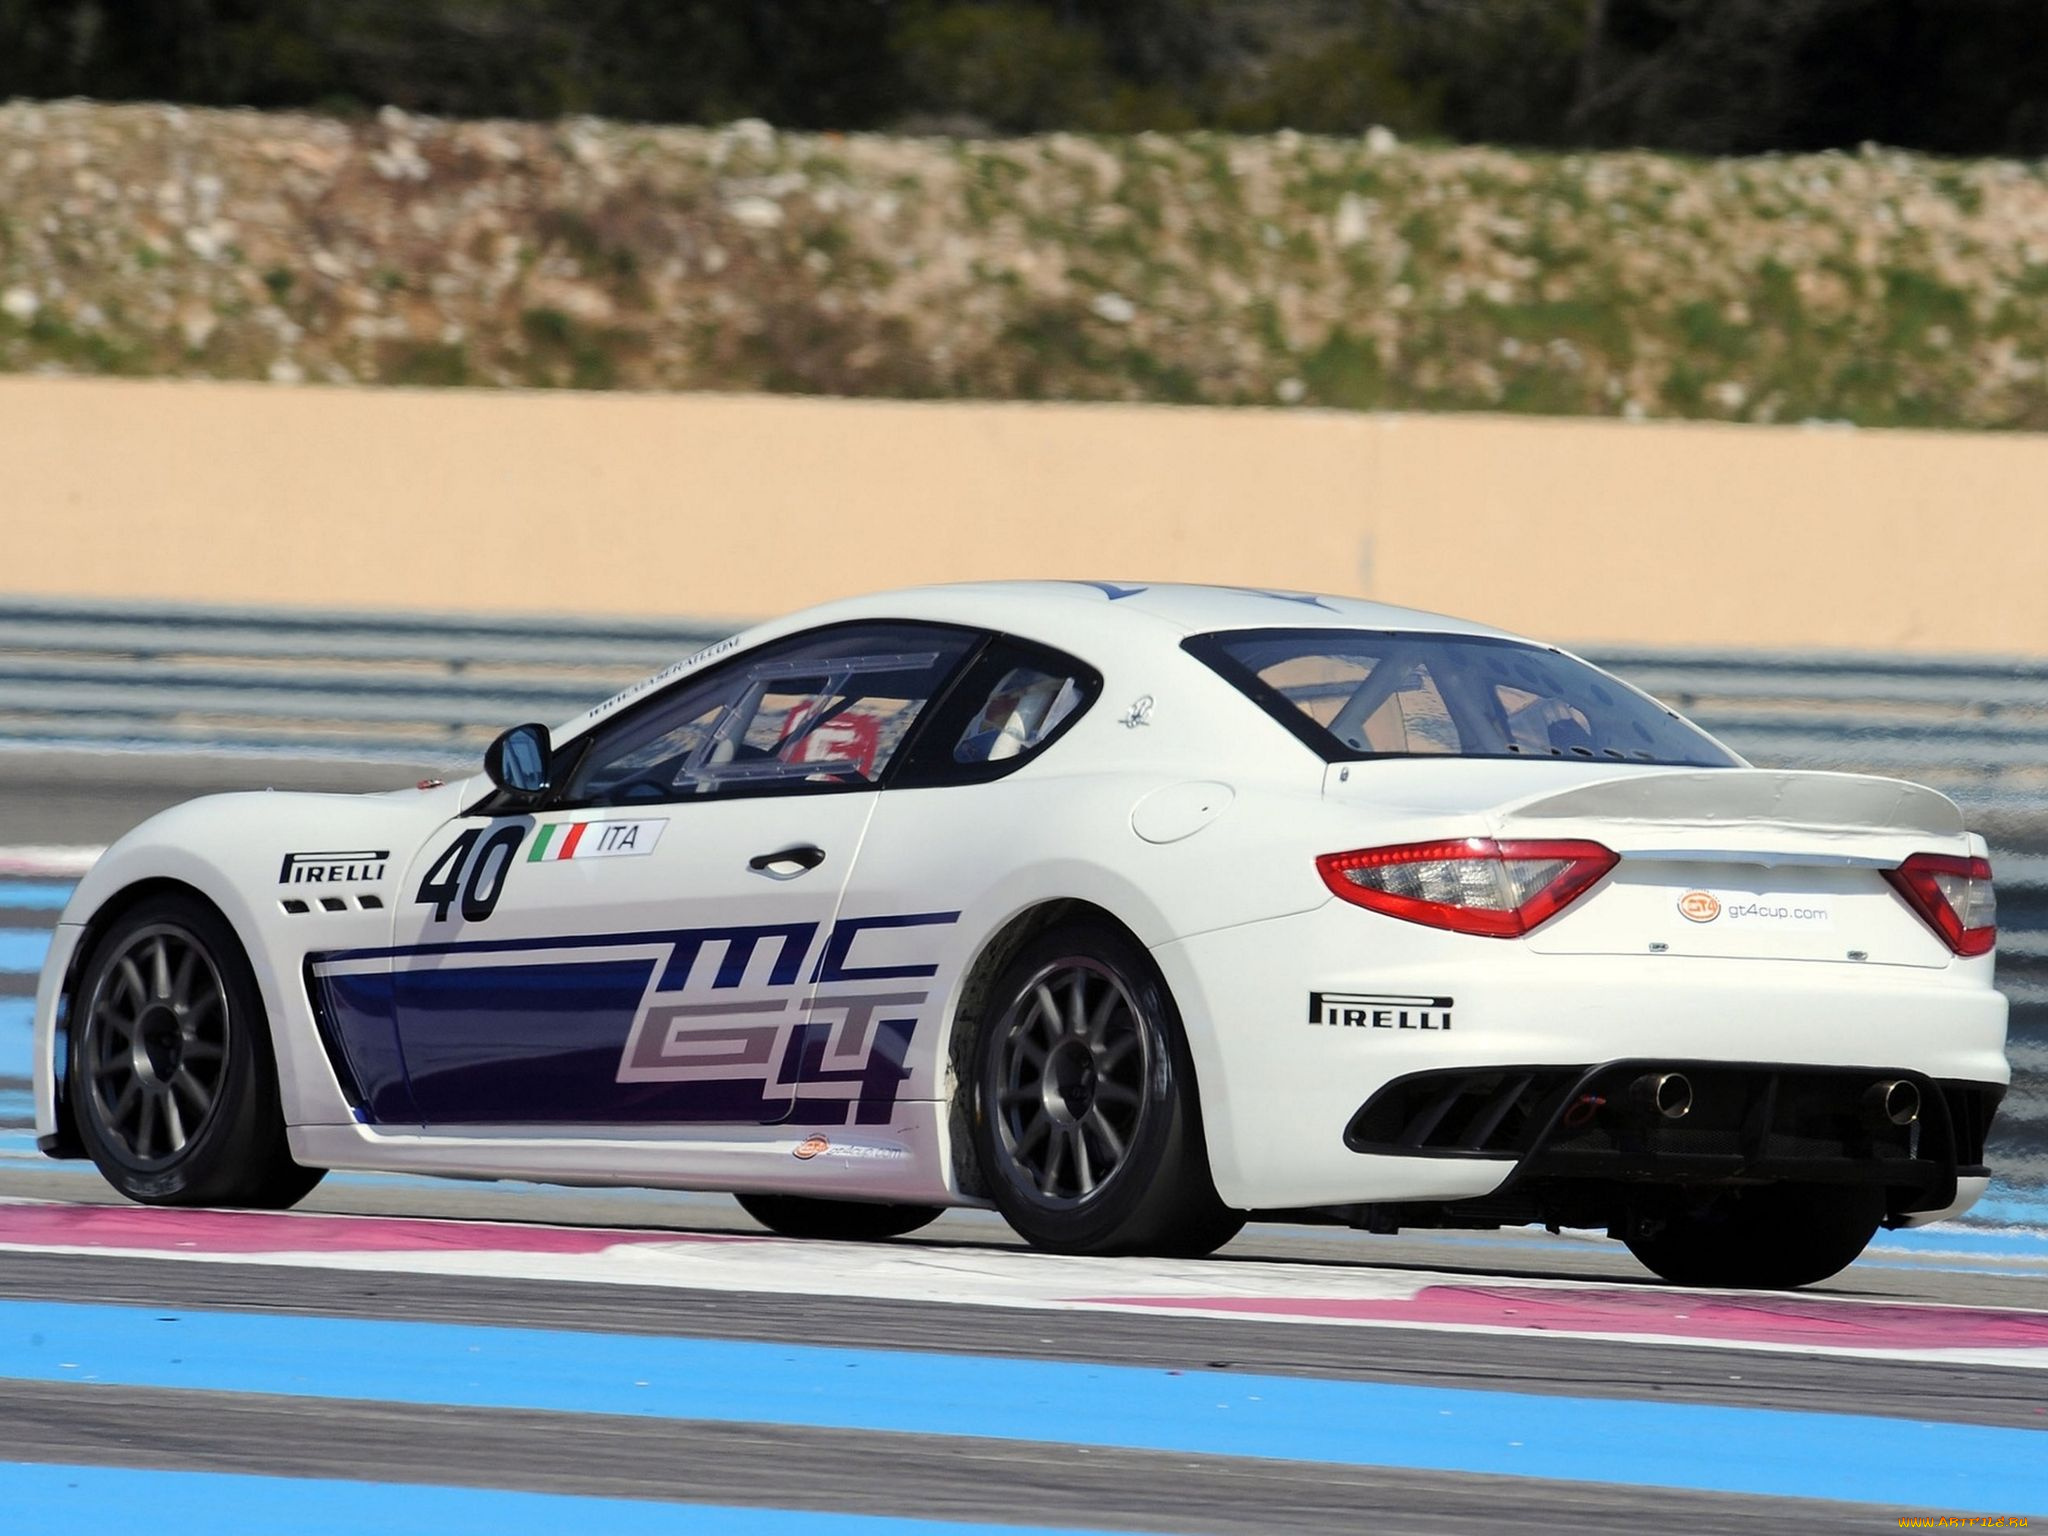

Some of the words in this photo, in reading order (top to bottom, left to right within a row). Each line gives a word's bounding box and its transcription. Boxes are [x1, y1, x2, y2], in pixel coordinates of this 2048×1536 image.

[596, 825, 640, 852] ITA
[279, 850, 390, 884] PIRELLI
[415, 827, 526, 923] 40
[1728, 903, 1828, 919] gt4cup.com
[1309, 991, 1454, 1030] PIRELLI
